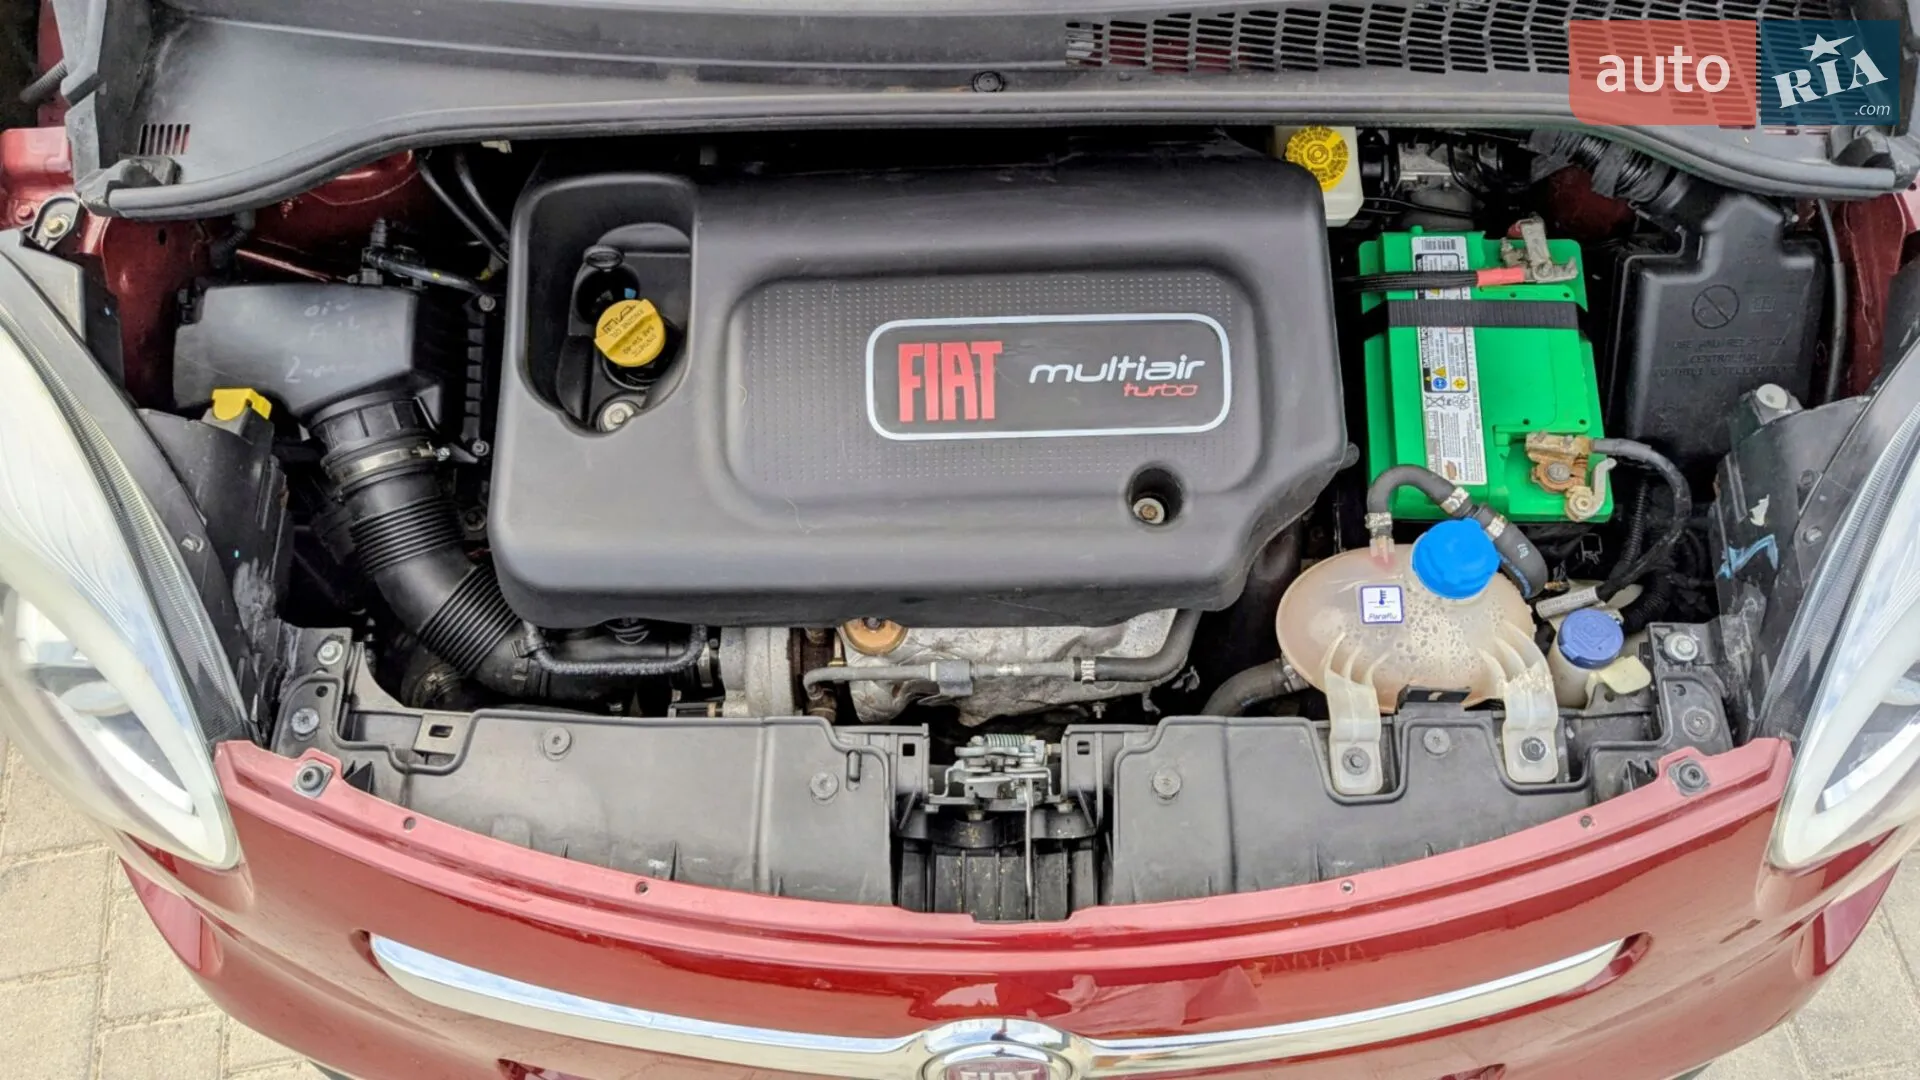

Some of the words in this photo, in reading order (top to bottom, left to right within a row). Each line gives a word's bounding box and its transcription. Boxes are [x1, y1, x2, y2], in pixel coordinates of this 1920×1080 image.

[1028, 355, 1206, 384] multiair
[898, 340, 1003, 423] FIAT
[1122, 382, 1200, 398] turbo
[1367, 612, 1398, 621] Paraflu
